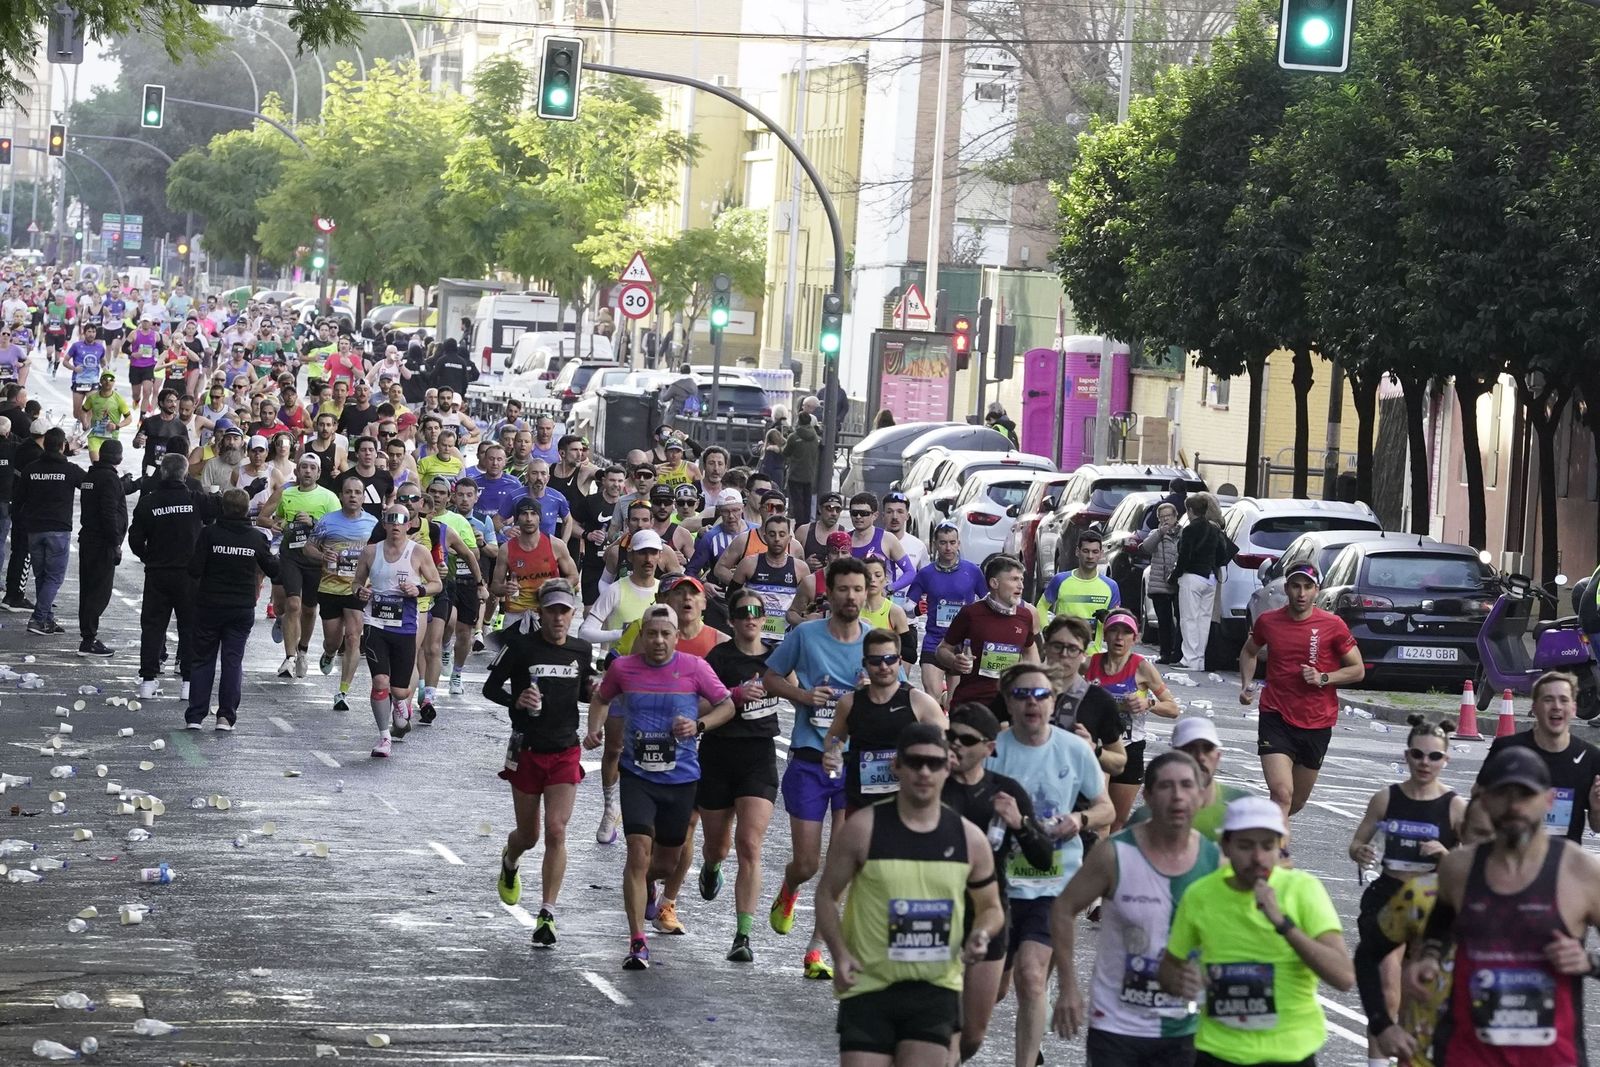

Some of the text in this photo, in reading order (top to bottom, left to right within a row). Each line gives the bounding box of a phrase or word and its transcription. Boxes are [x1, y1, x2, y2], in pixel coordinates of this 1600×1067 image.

[626, 295, 646, 307] 30
[30, 473, 66, 481] VOLUNTEER
[152, 505, 194, 517] VOLUNTEER
[212, 545, 256, 557] VOLUNTEER
[379, 611, 394, 619] JOHN
[1309, 635, 1319, 665] AMBAR
[1406, 648, 1456, 660] 4249 GBR
[1561, 648, 1580, 657] cabify
[643, 752, 664, 762] ALEX
[1401, 824, 1433, 834] ZURICH
[912, 902, 948, 912] ZURICH
[896, 932, 945, 947] DAVID L.
[1120, 987, 1153, 1007] JOSÉ
[1215, 997, 1268, 1015] CARLOS
